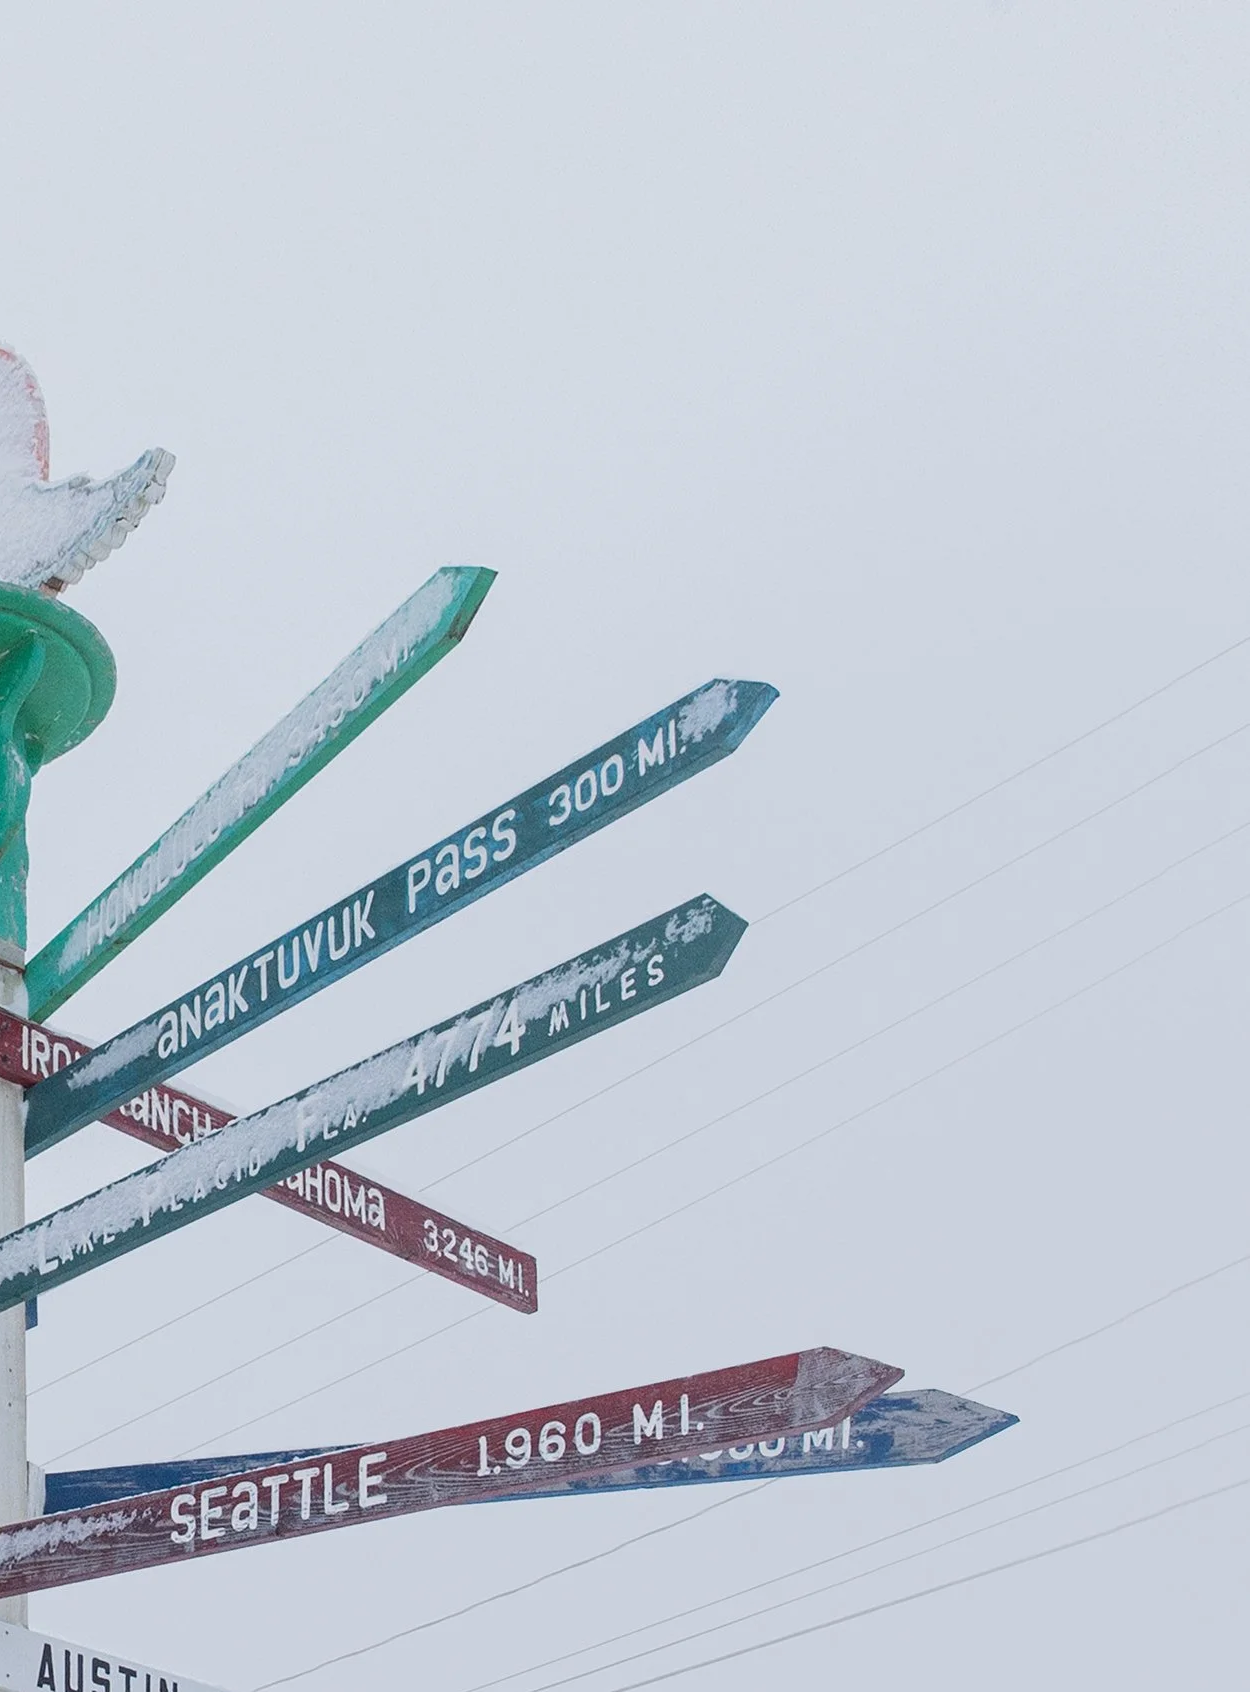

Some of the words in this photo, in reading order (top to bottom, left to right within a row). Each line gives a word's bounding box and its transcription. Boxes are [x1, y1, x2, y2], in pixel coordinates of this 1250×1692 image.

[548, 752, 626, 826] 300
[638, 720, 687, 777] MI.
[547, 955, 666, 1036] MILES
[21, 1025, 80, 1079] IRO
[499, 1254, 530, 1297] MI.
[476, 1412, 602, 1478] 1.960
[633, 1393, 704, 1446] MI.
